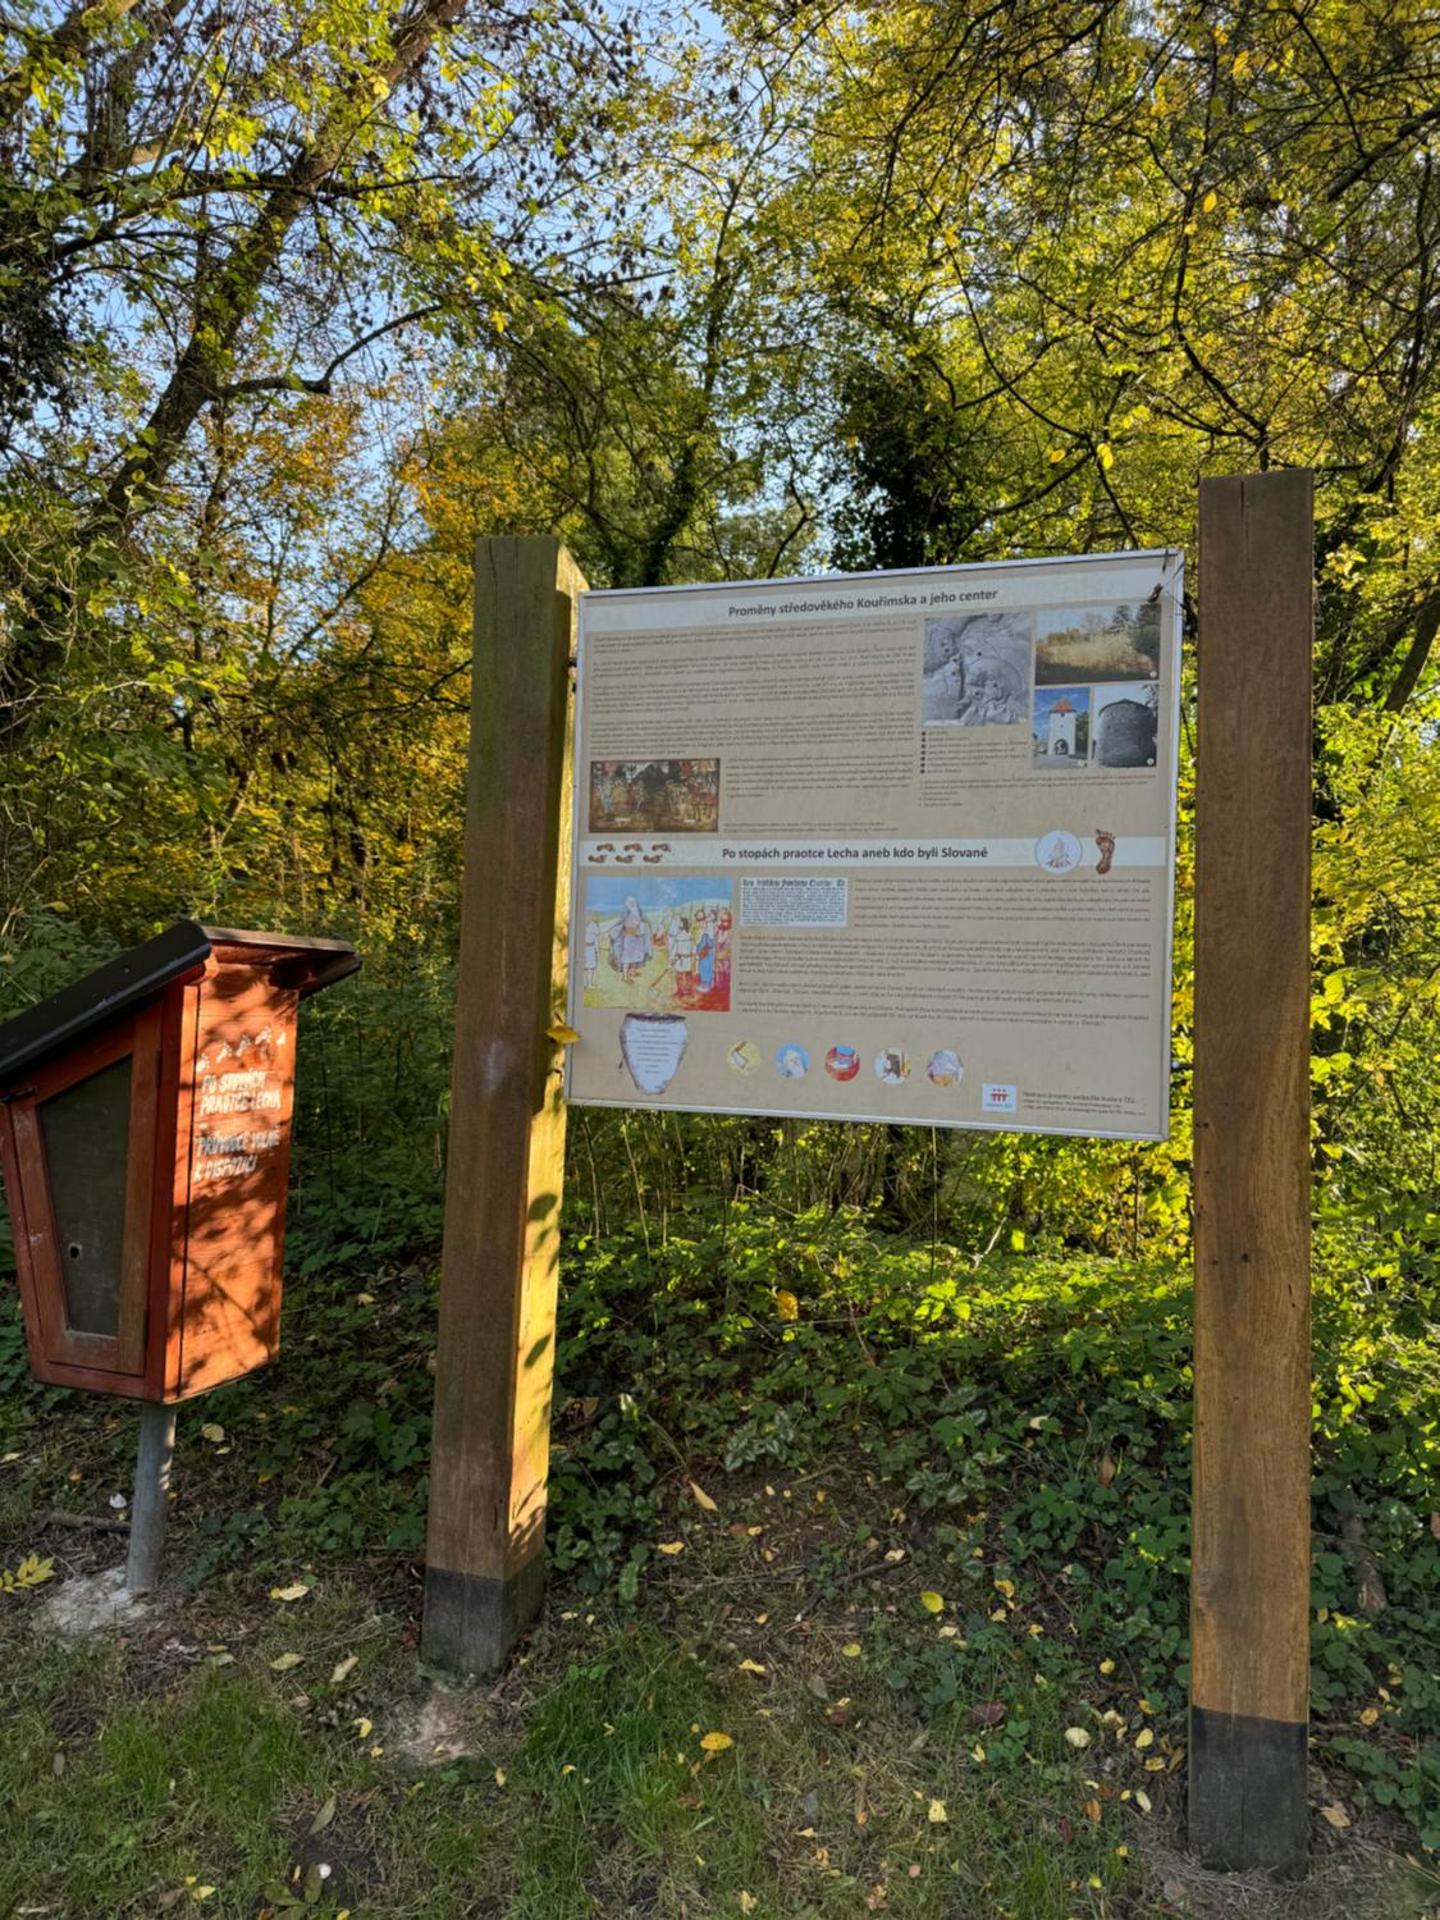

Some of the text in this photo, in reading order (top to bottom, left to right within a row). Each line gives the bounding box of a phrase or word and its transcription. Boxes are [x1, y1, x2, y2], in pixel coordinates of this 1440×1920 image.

[728, 589, 998, 618] Proměny středověkého Kouřimska a jeho center
[722, 845, 989, 861] Po stopách praotce Lecha aneb kdo byli Slované
[201, 1075, 217, 1094] PO
